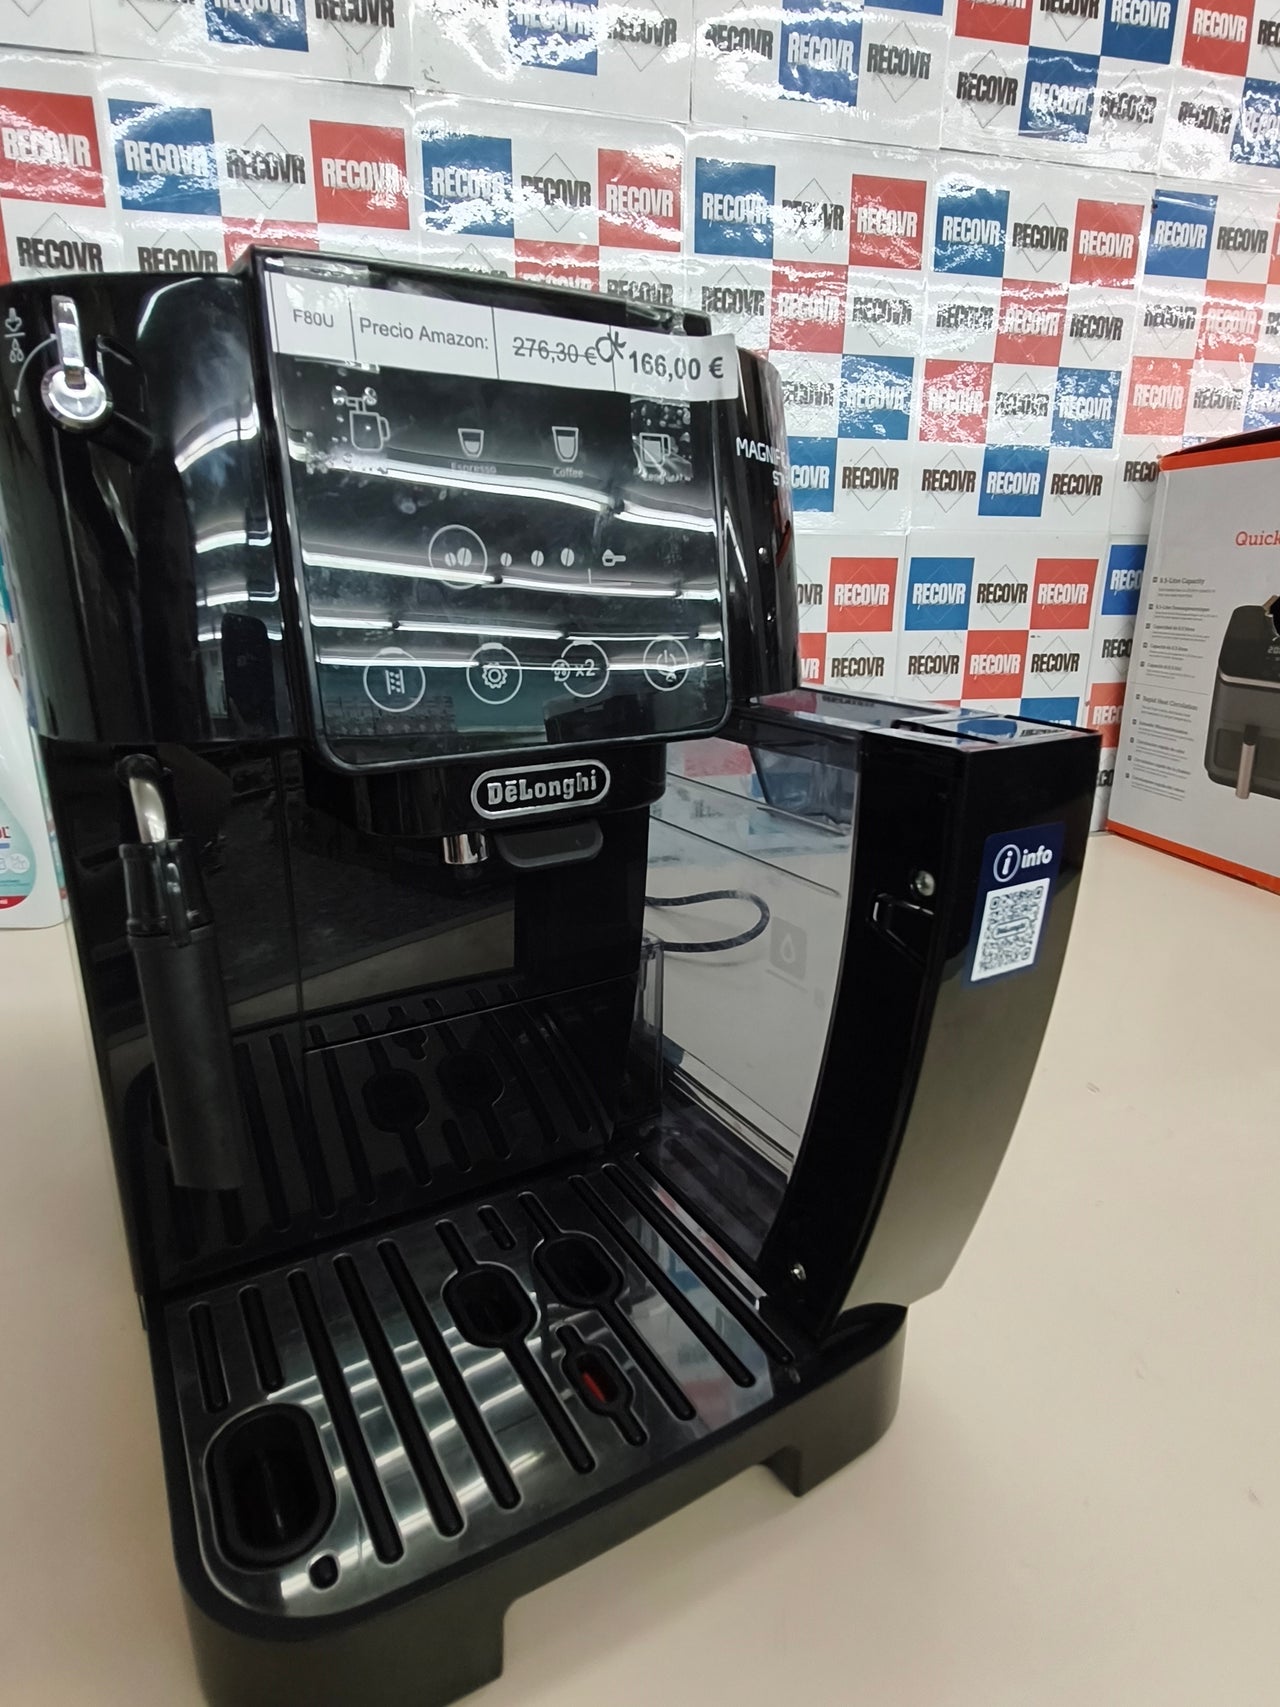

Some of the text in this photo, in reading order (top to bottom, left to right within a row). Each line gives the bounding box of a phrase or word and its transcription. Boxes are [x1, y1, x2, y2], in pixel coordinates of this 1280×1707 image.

[1110, 0, 1170, 29] RECOVR
[1192, 7, 1247, 43] RECOVR
[787, 33, 854, 70] RECOVR
[865, 43, 931, 80] RECOVR
[956, 71, 1018, 106] RECOVR
[4, 128, 91, 167] RECOVR
[124, 140, 209, 177] RECOVR
[322, 157, 402, 194] RECOVR
[606, 184, 674, 217] RECOVR
[702, 192, 768, 225] RECOVR
[857, 207, 917, 239] RECOVR
[943, 215, 1001, 247] RECOVR
[1155, 220, 1207, 250] RECOVR
[1013, 221, 1068, 253] RECOVR
[1080, 229, 1134, 260] RECOVR
[1217, 226, 1269, 254] RECOVR
[17, 236, 101, 271] RECOVR
[702, 286, 765, 316] RECOVR
[1004, 308, 1060, 337] RECOVR
[1069, 314, 1124, 341] RECOVR
[1206, 308, 1257, 335] RECOVR
[293, 310, 335, 330] F80U
[360, 317, 413, 341] Precio
[420, 326, 489, 350] Amazon:
[512, 335, 579, 365] 276,30
[628, 350, 701, 382] 166,00
[708, 356, 724, 379] €
[1059, 394, 1112, 420] RECOVR
[1133, 384, 1184, 409] RECOVR
[553, 466, 584, 479] Coffee
[791, 464, 830, 489] COVR
[842, 466, 899, 491] RECOVR
[922, 468, 976, 493] RECOVR
[987, 471, 1041, 495] RECOVR
[1051, 472, 1103, 497] RECOVR
[977, 582, 1028, 605] RECOVR
[1037, 582, 1089, 605] RECOVR
[1110, 569, 1143, 591] RECO
[834, 583, 890, 605] RECOVR
[912, 583, 966, 605] RECOVR
[831, 656, 885, 678] RECOVR
[908, 655, 960, 677] RECOVR
[969, 654, 1022, 676] RECOVR
[1031, 652, 1080, 674] RECOVR
[1021, 845, 1053, 869] info
